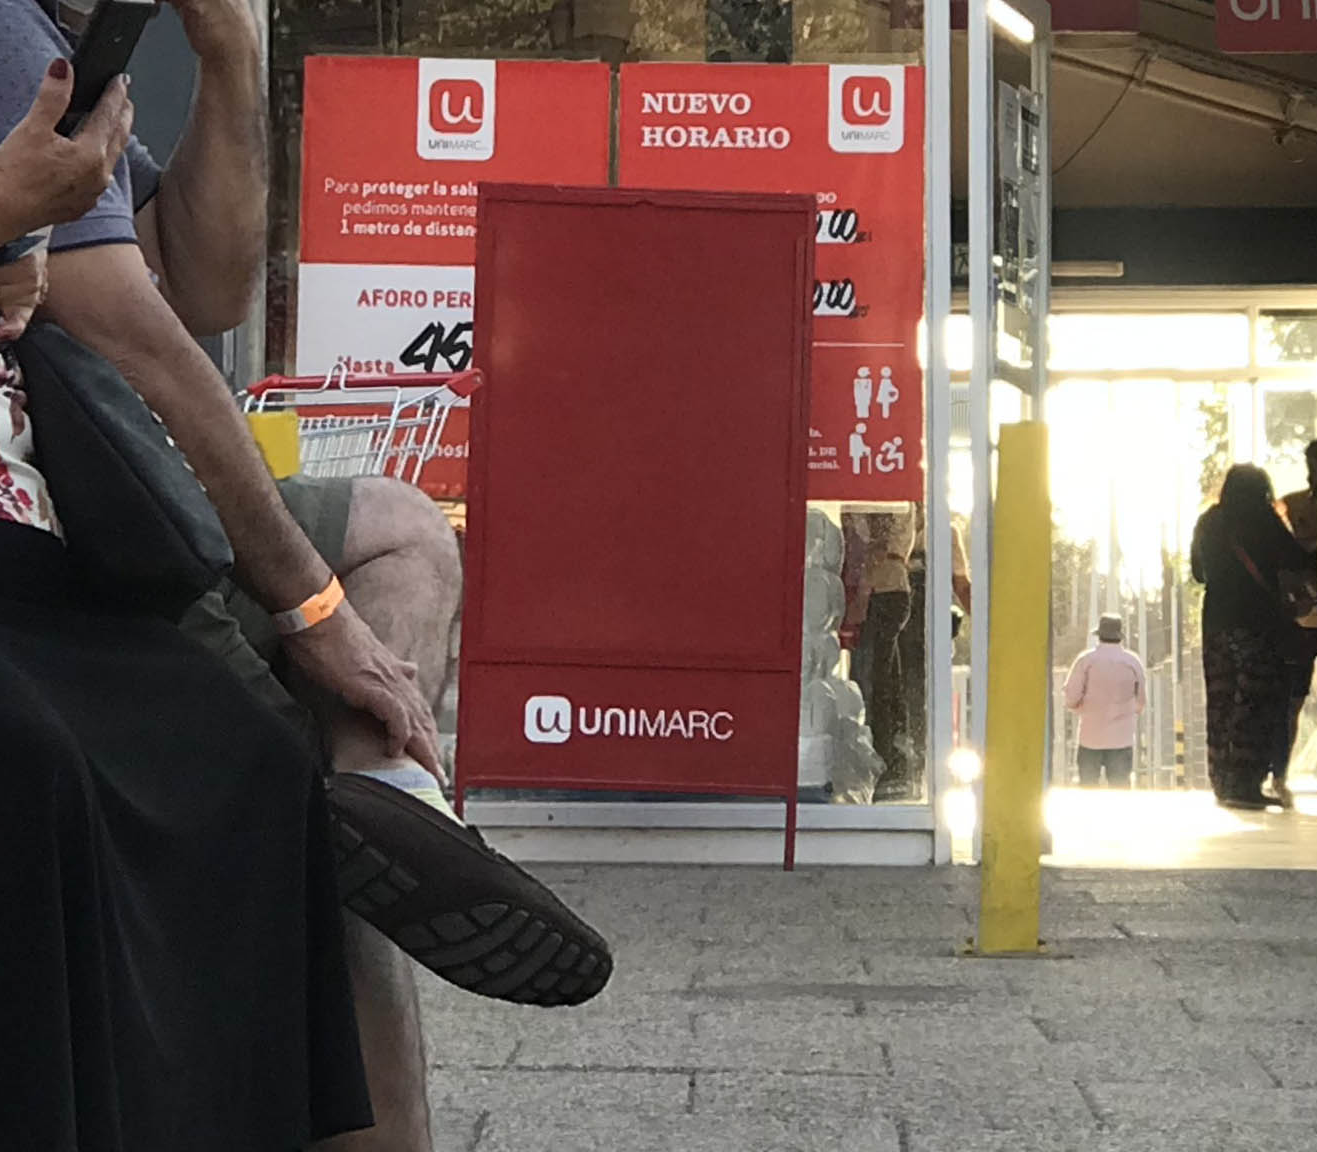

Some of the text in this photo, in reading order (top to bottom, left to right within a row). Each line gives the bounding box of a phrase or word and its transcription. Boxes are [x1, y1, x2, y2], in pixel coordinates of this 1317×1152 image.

[641, 92, 752, 115] NUEVO
[640, 126, 791, 149] HORARIO
[324, 178, 359, 193] Para
[362, 181, 429, 199] proteger
[433, 181, 447, 196] la
[343, 201, 407, 217] pedimos
[340, 219, 477, 237] 1 metro de distan
[357, 289, 474, 309] AFORO PER
[578, 706, 734, 741] UNIMARC
